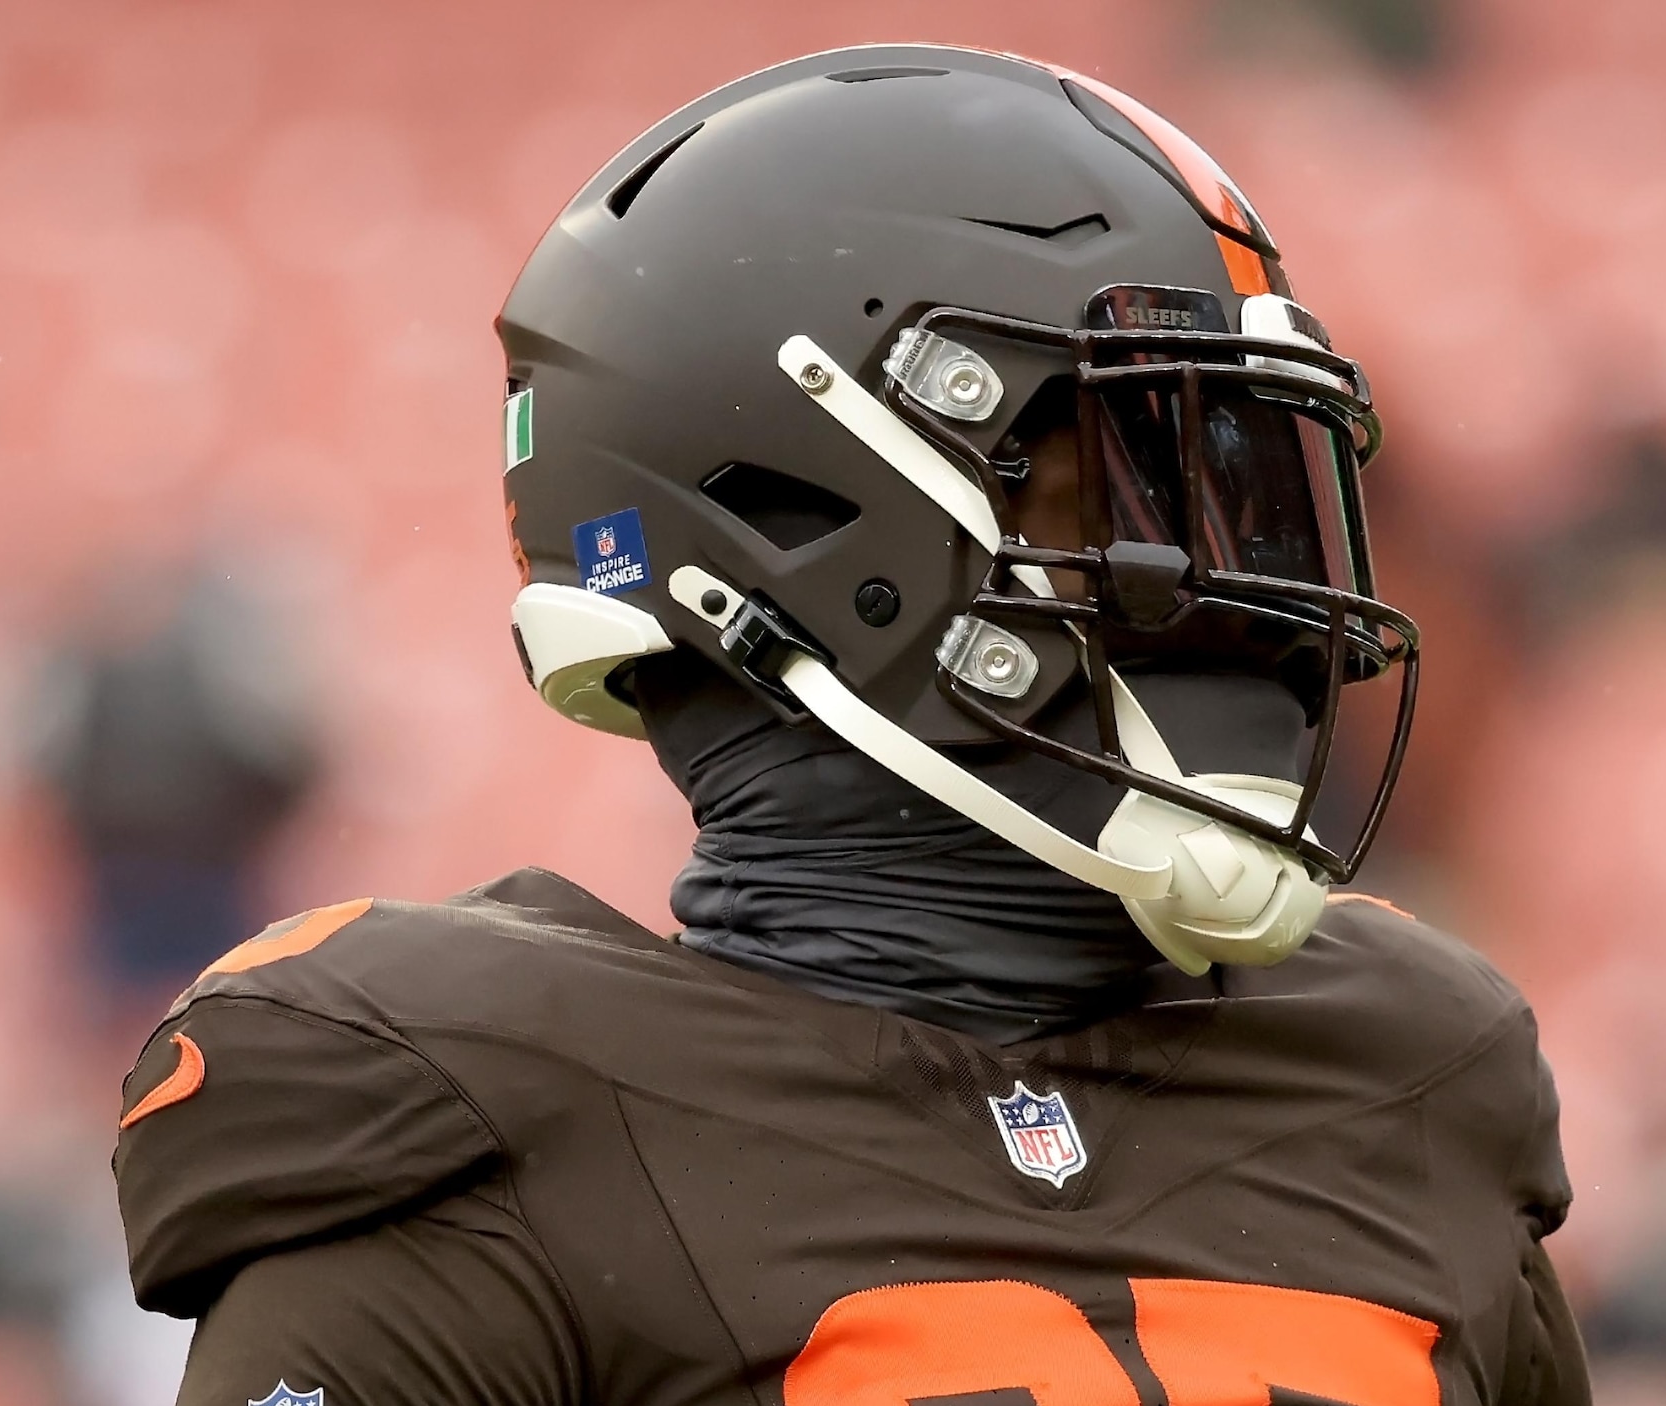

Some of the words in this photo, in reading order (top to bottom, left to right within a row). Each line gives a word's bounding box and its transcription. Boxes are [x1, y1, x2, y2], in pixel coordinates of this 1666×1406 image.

[1126, 307, 1191, 327] SLEEFS
[586, 563, 644, 593] CHANGE
[592, 554, 630, 576] INSPIRE
[1015, 1129, 1074, 1167] NFL
